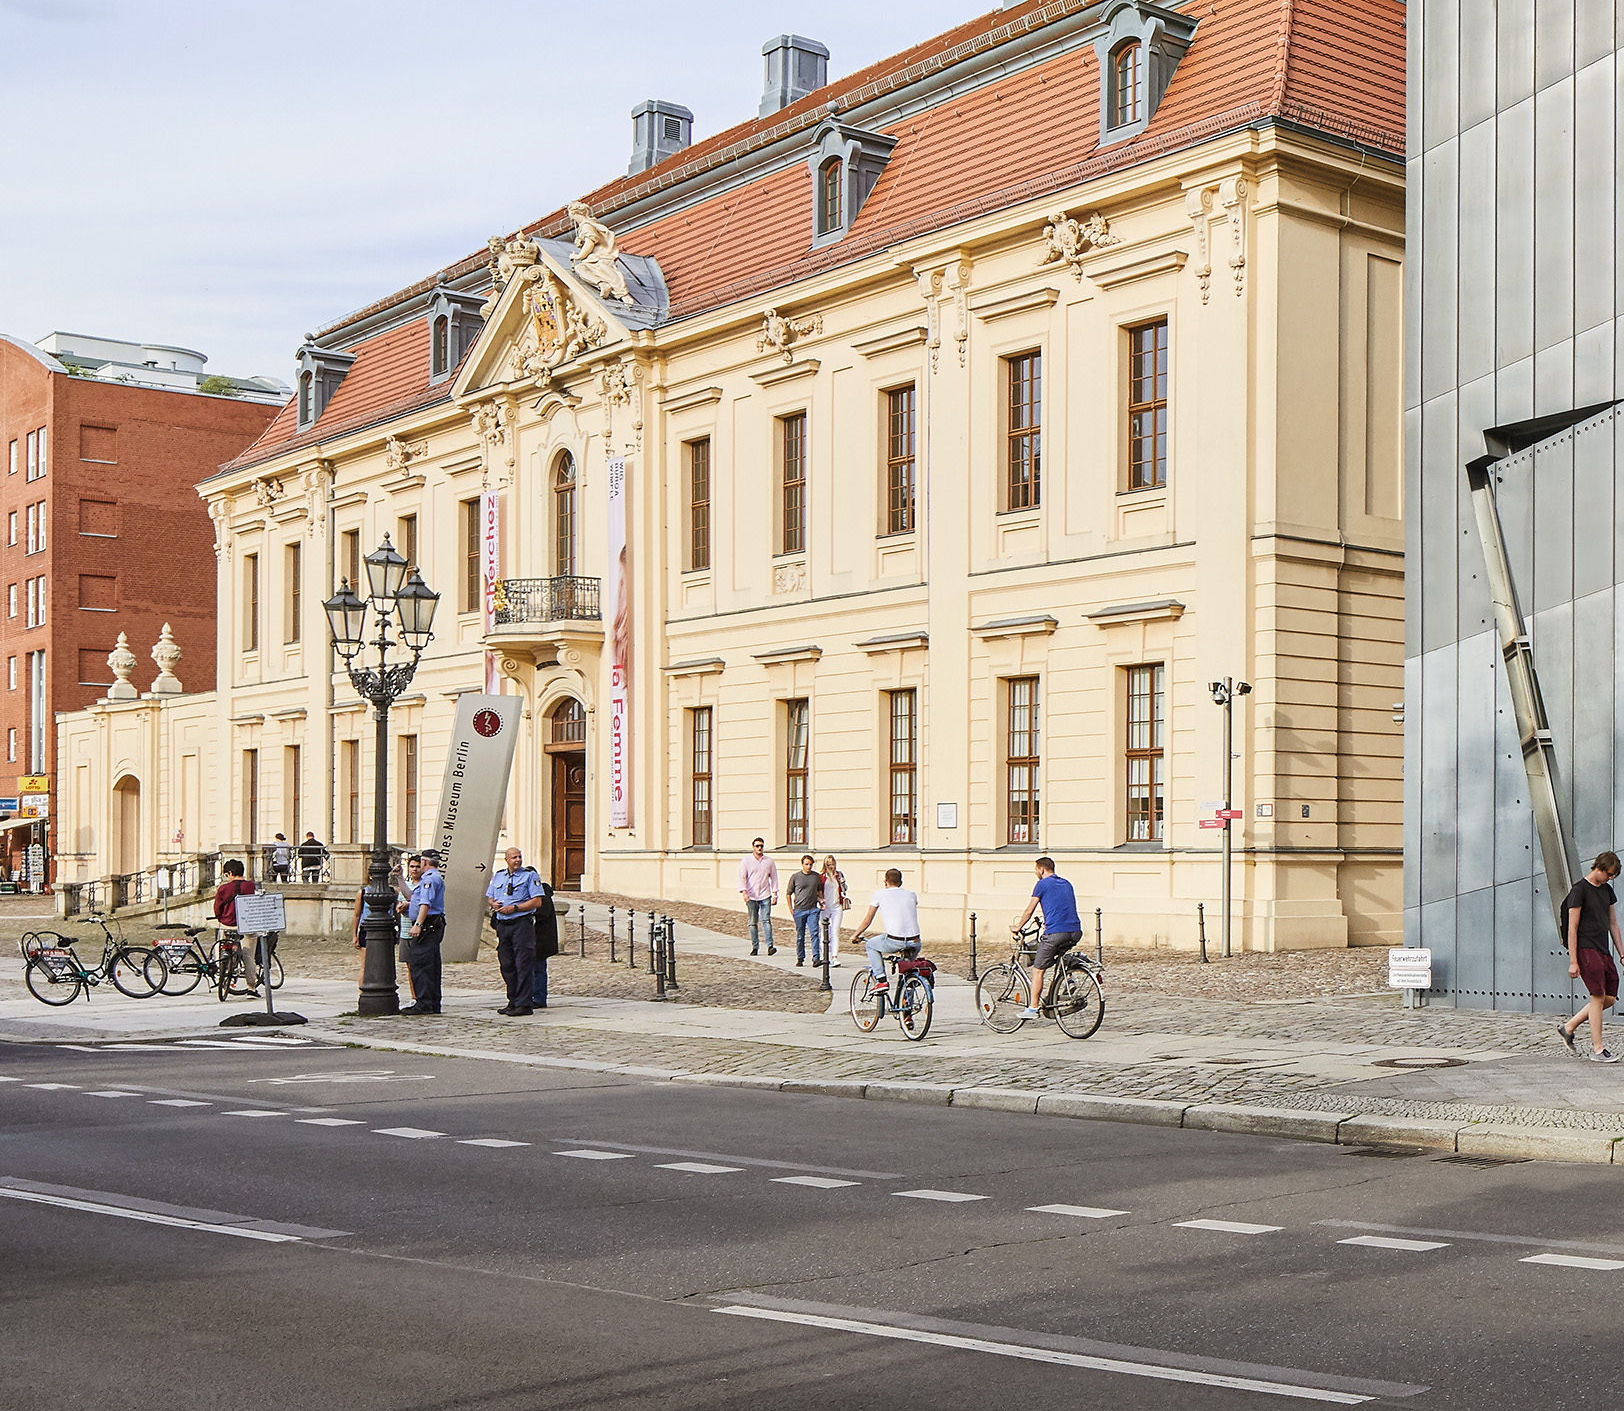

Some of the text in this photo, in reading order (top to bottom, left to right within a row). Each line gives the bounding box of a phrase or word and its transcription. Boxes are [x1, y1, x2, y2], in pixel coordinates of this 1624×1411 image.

[486, 495, 496, 615] Cherchez
[612, 664, 624, 687] la
[612, 698, 624, 803] Femme
[438, 740, 470, 880] isches Museum Berlin
